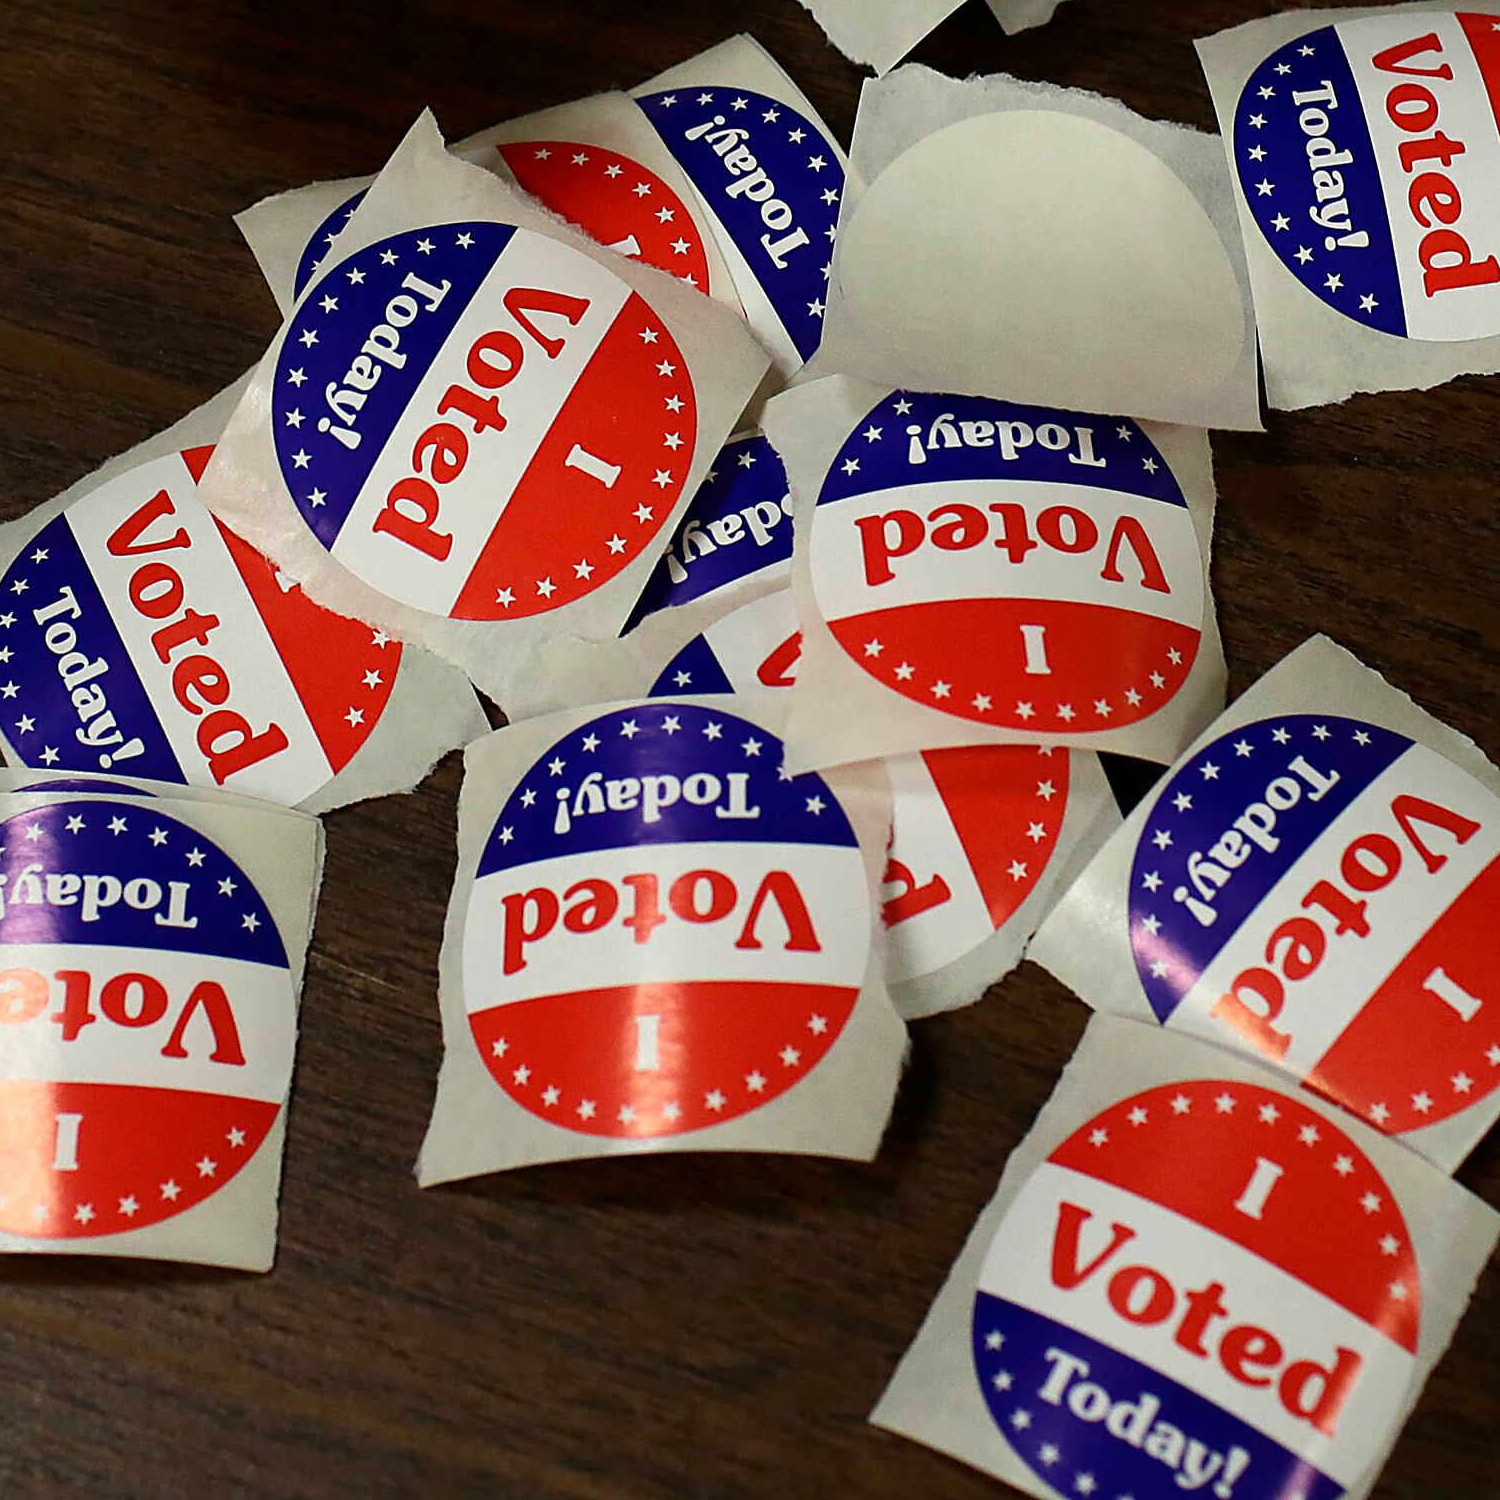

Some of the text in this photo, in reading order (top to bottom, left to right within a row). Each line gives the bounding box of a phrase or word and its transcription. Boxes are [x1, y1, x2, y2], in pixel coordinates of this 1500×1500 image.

[684, 114, 810, 269] Today!
[1292, 80, 1369, 251] Today!
[318, 271, 452, 451] Today!
[372, 287, 592, 563] Voted
[565, 443, 622, 488] I
[905, 413, 1106, 468] Today!
[667, 492, 794, 584] day!
[854, 501, 1171, 594] Voted
[32, 585, 145, 770] Today!
[106, 489, 290, 787] Voted
[1019, 624, 1051, 674] I
[553, 772, 760, 835] Today!
[1172, 755, 1341, 927] Today!
[502, 869, 822, 976] Voted
[1208, 794, 1482, 1062] Voted
[635, 1014, 661, 1071] I
[1422, 967, 1483, 1022] I
[52, 1113, 83, 1170] I
[1234, 1157, 1284, 1220] I
[1045, 1200, 1365, 1439] Voted
[1036, 1347, 1252, 1499] Today!
